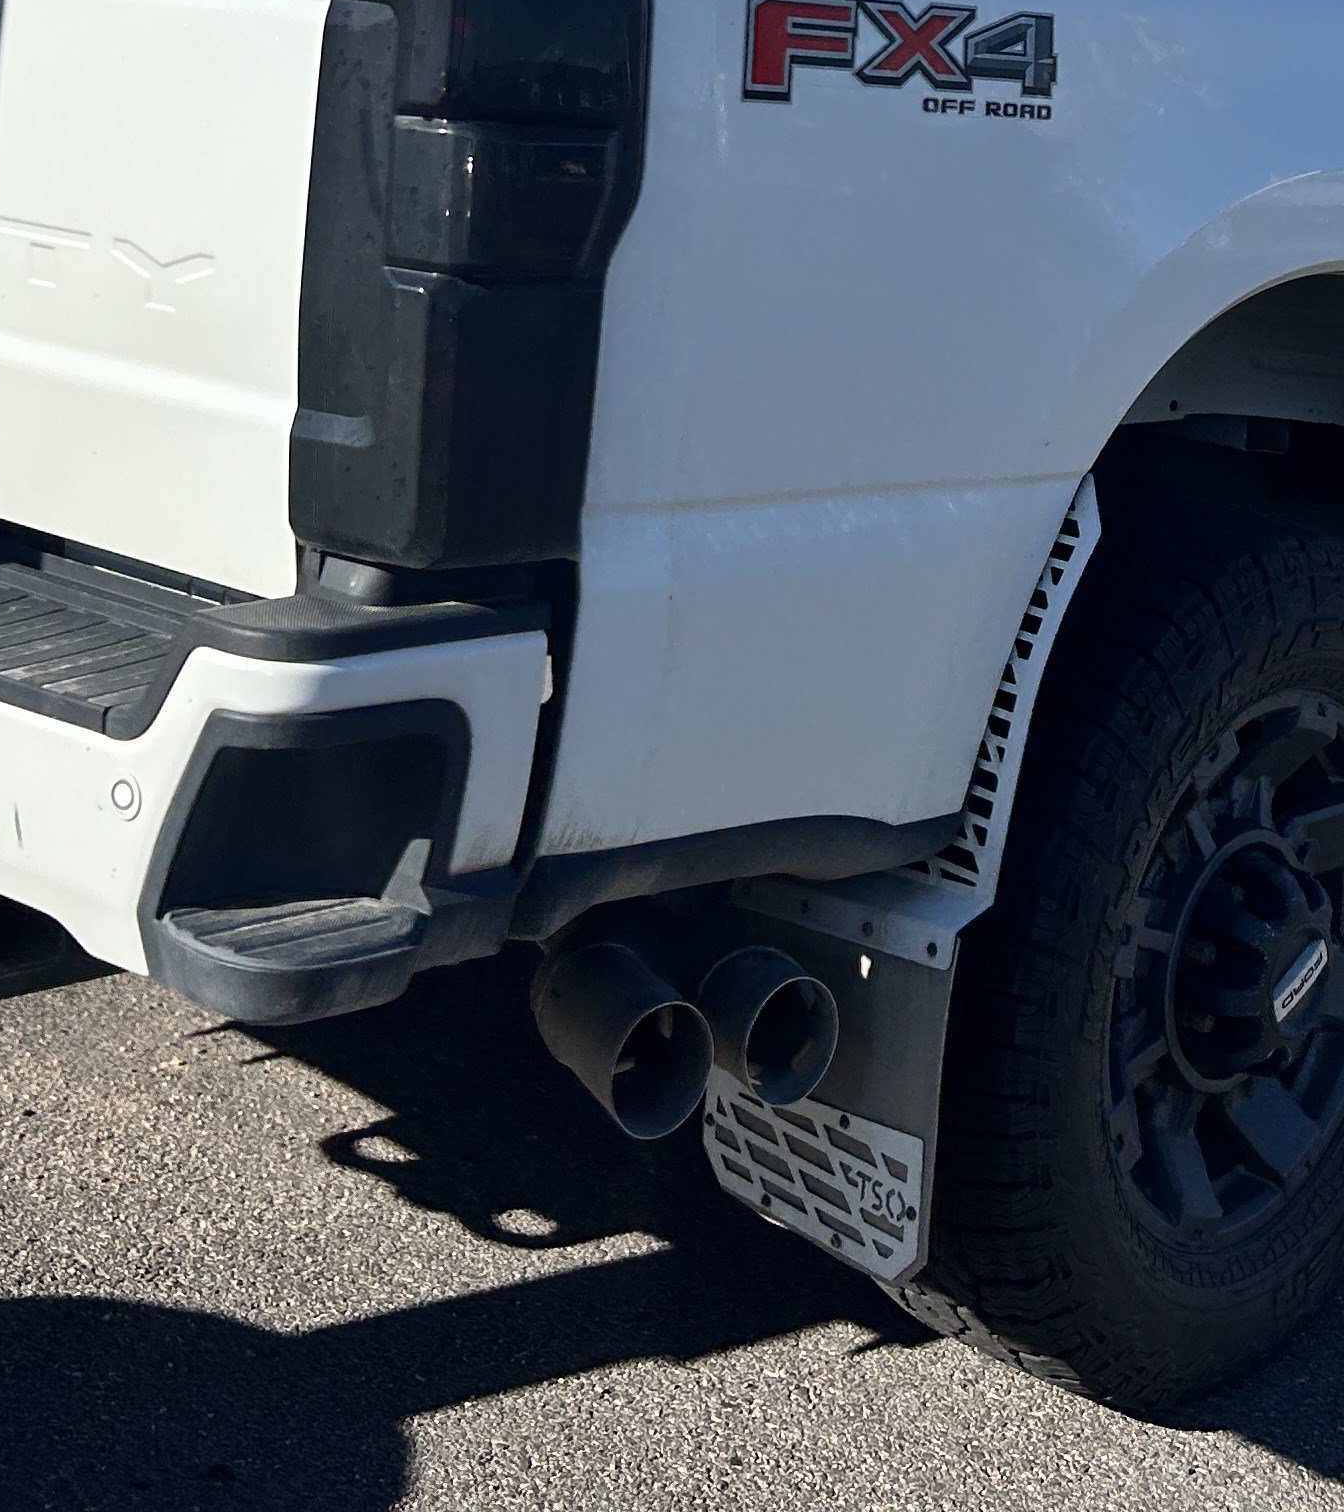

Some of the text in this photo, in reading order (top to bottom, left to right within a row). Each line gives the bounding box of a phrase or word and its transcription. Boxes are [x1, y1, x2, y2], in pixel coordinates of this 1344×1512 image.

[922, 97, 1053, 121] OFF ROAD
[1281, 952, 1324, 1009] FORD
[855, 1169, 908, 1222] TSO
